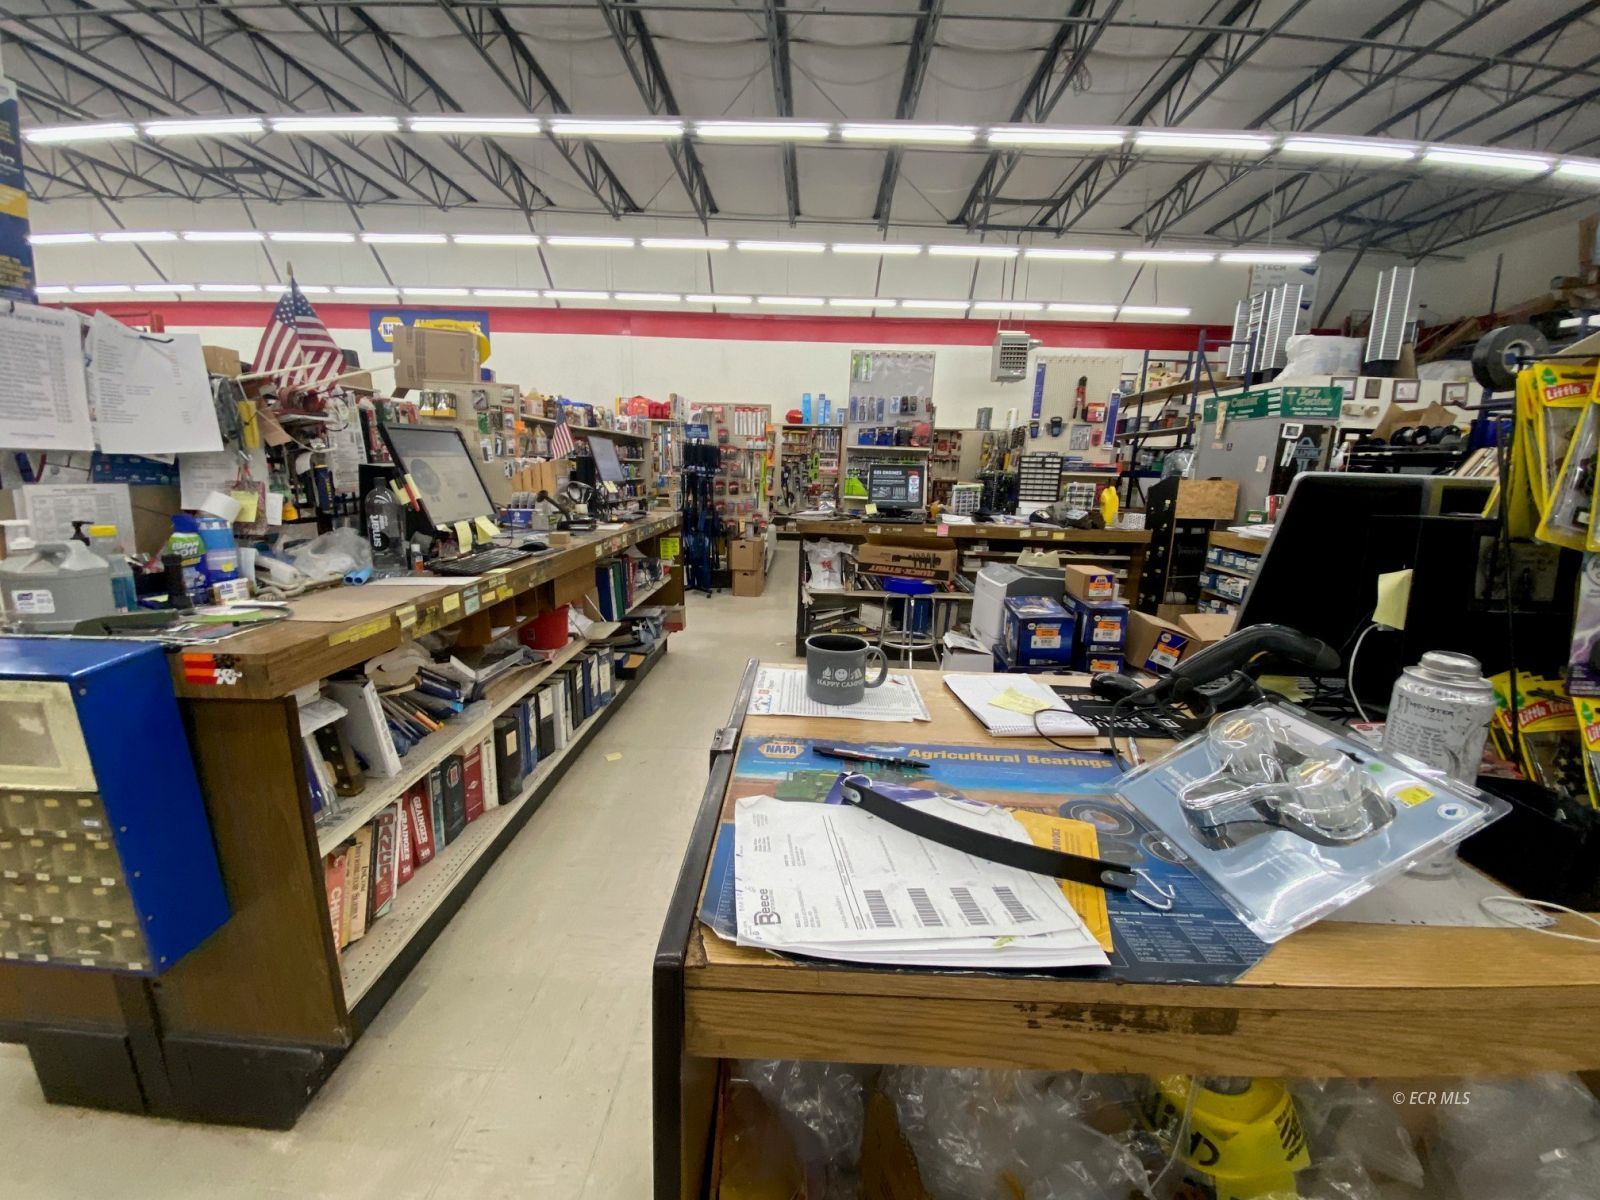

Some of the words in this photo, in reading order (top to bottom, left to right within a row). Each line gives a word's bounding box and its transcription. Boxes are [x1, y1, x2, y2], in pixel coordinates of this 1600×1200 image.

[817, 678, 840, 688] HAPPY
[765, 744, 797, 755] NAPA
[907, 748, 1020, 764] Agricultural
[1026, 754, 1112, 769] Bearings
[412, 796, 429, 843] GRAINGER
